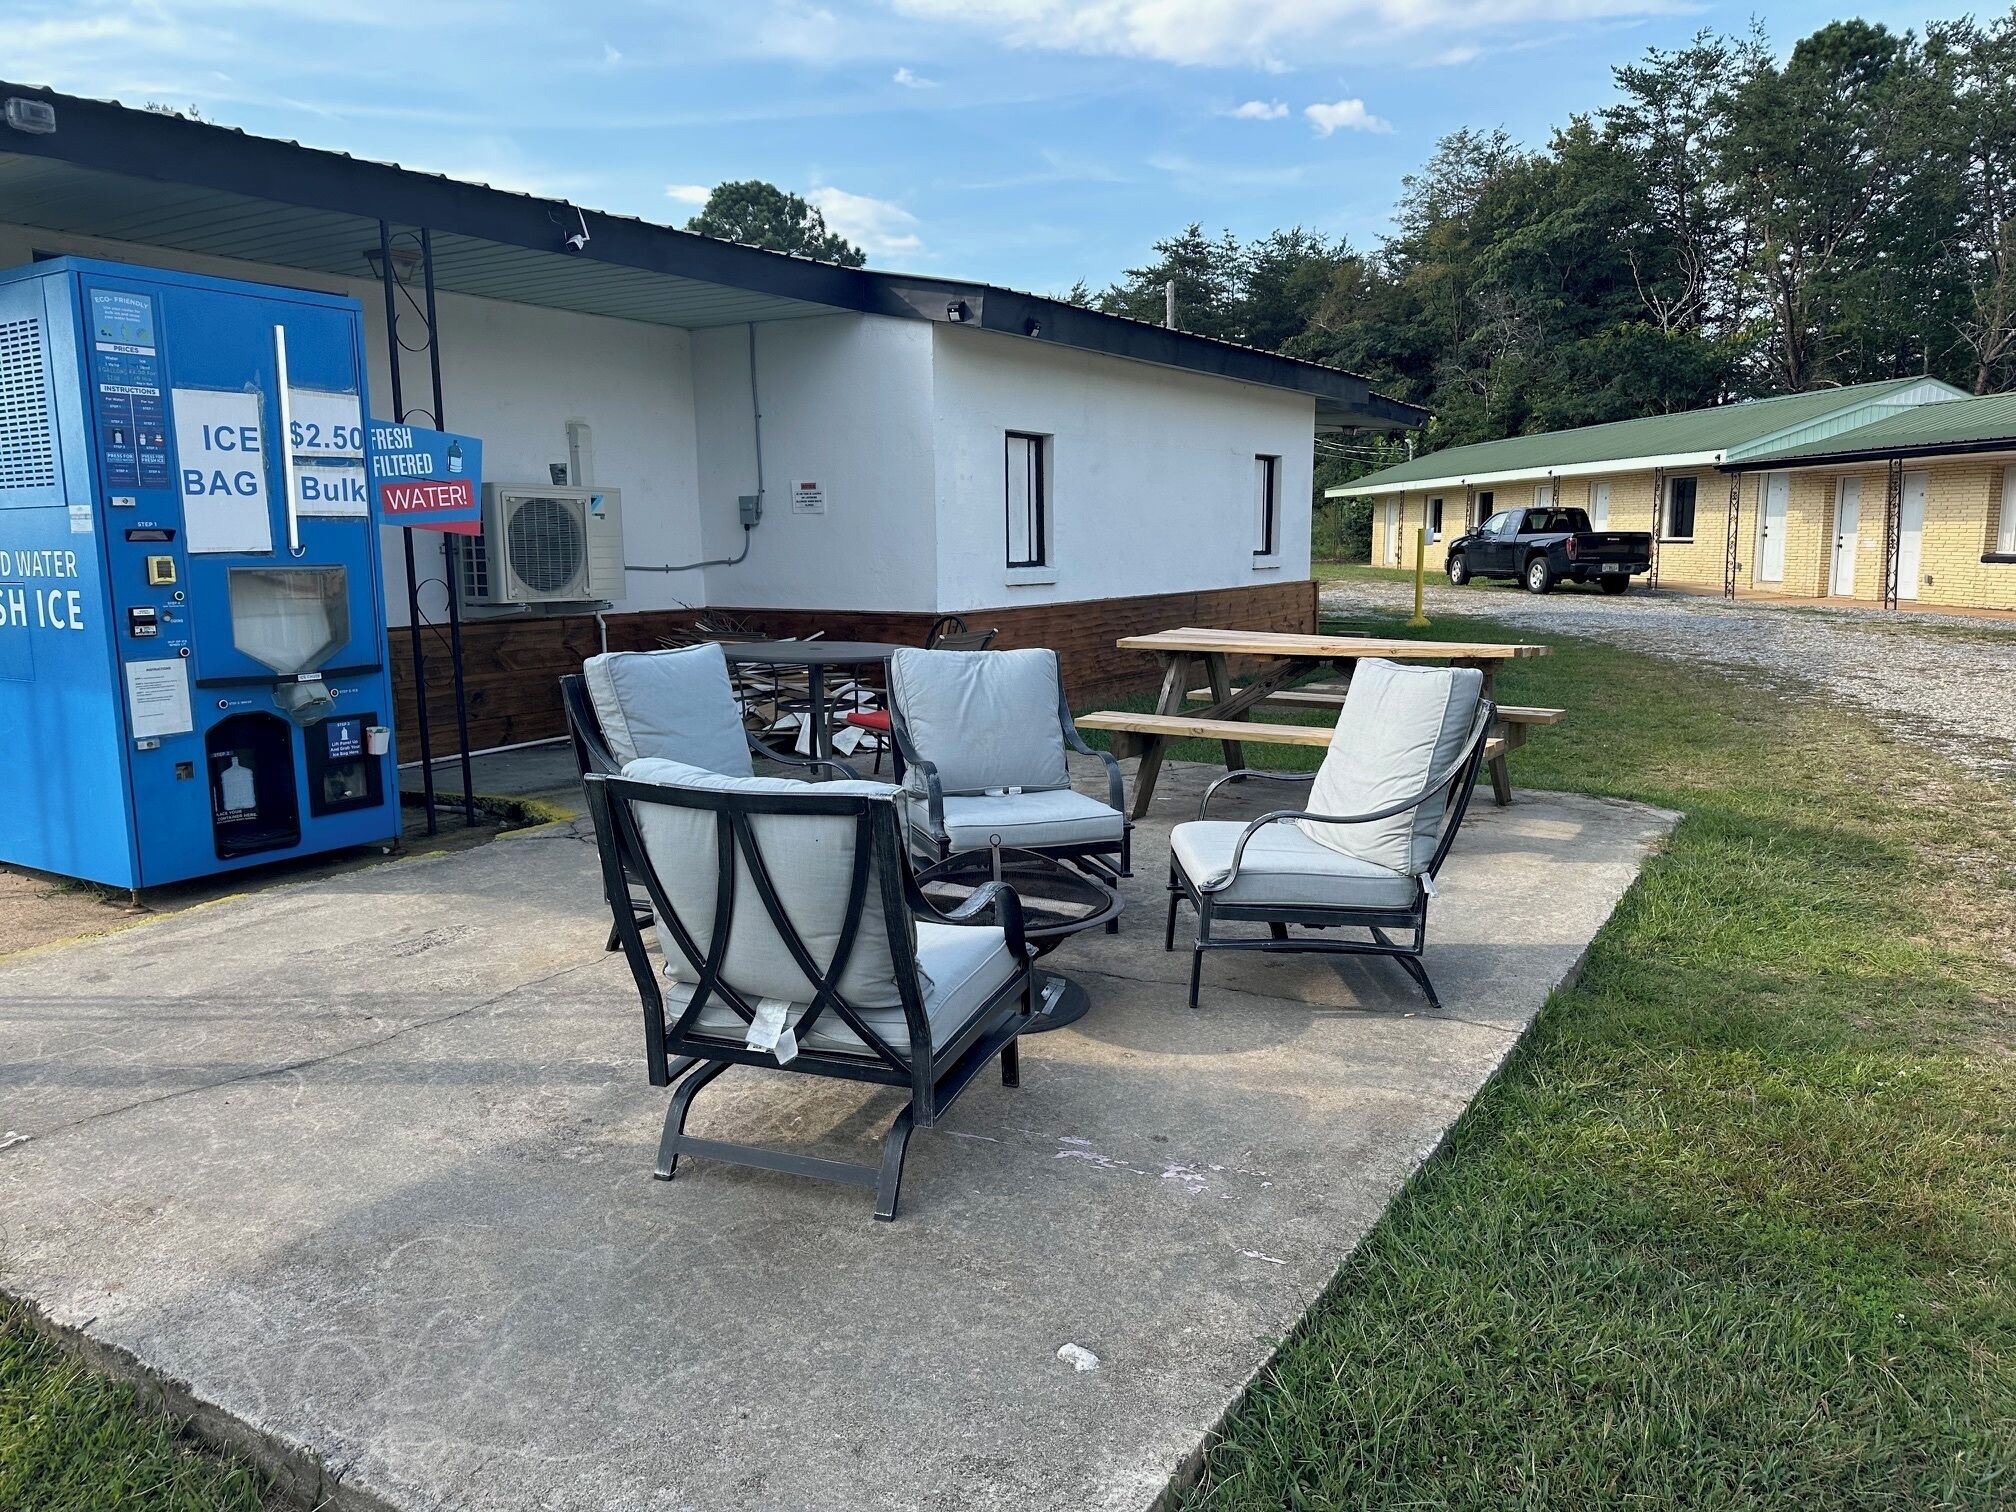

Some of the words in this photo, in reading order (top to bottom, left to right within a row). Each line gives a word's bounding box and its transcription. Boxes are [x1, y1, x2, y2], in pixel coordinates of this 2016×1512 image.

[114, 297, 149, 309] FRIENDLY
[113, 345, 139, 353] PRICES
[104, 386, 156, 395] INSTRUCTIONS
[203, 425, 260, 452] ICE
[290, 421, 364, 450] $2.50
[371, 427, 413, 450] FRESH
[373, 453, 433, 477] FILTERED
[183, 469, 258, 496] BAG
[301, 476, 366, 501] Bulk
[386, 485, 468, 510] WATER!
[15, 551, 78, 577] WATER
[36, 589, 84, 630] ICE
